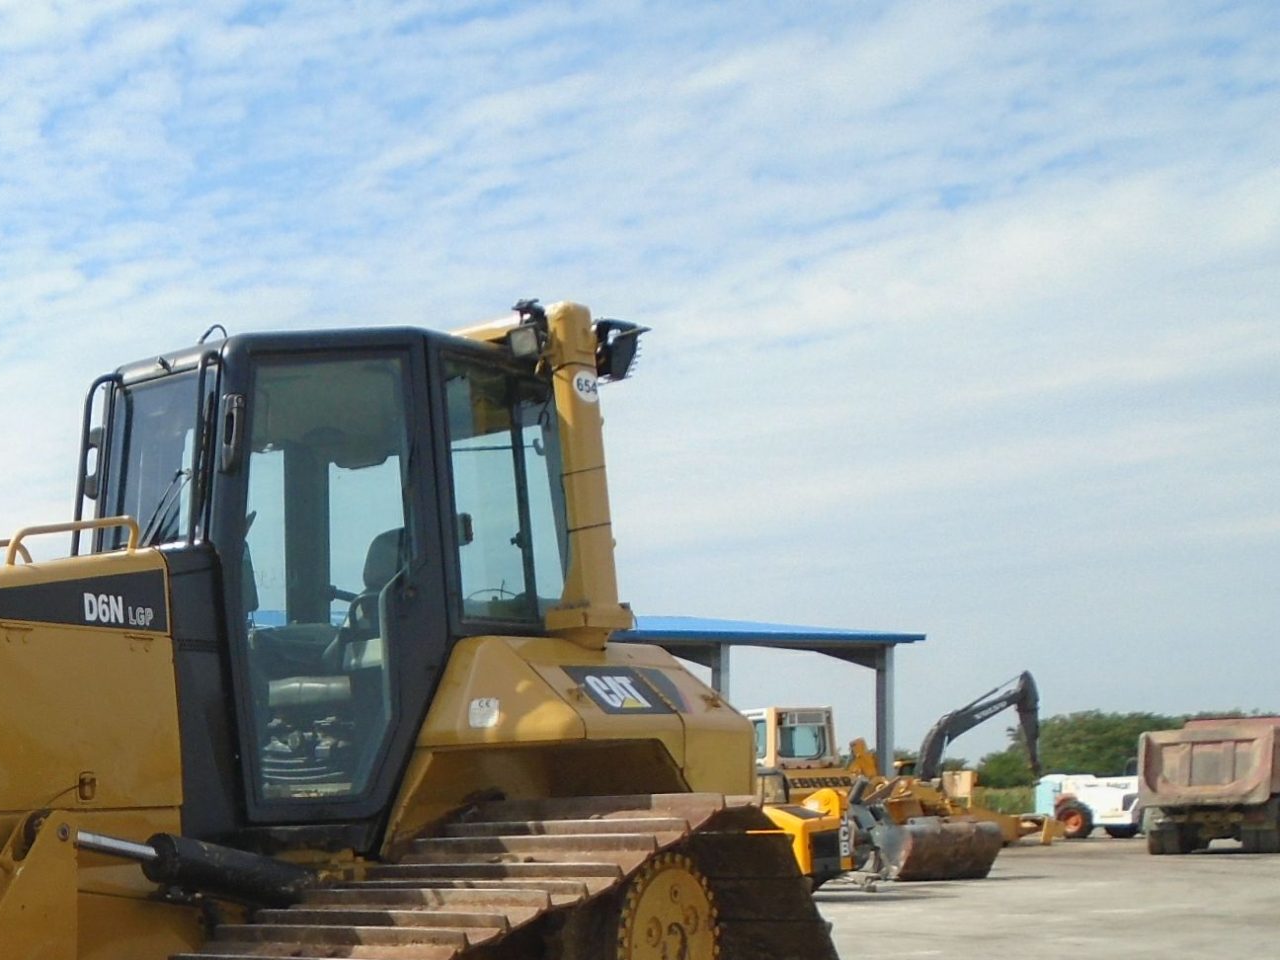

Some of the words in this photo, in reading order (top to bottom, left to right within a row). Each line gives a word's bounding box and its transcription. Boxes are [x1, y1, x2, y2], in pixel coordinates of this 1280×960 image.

[83, 592, 125, 624] D6N
[127, 605, 154, 626] LGP
[584, 674, 652, 708] CAT
[788, 776, 852, 789] EBHERR
